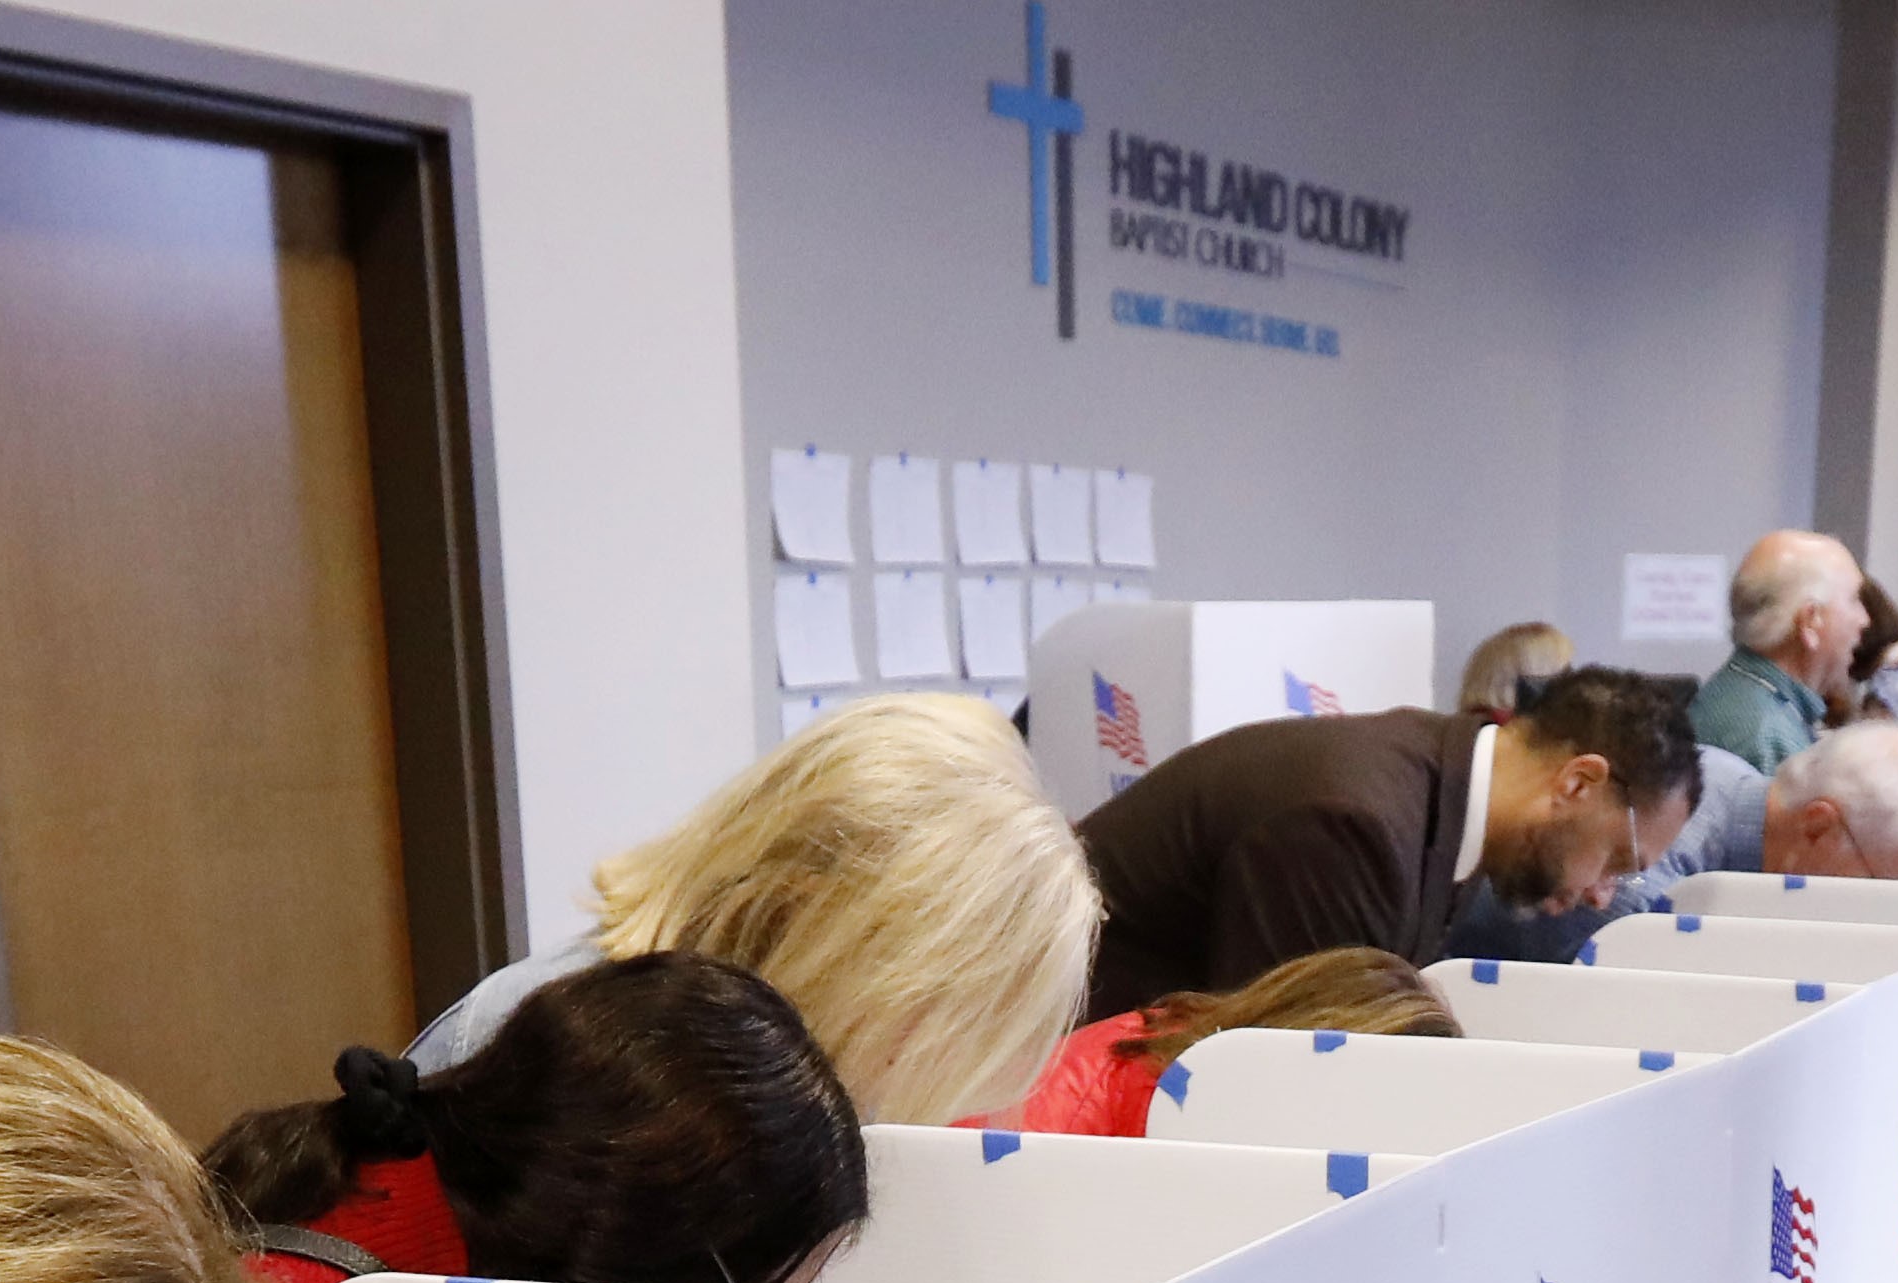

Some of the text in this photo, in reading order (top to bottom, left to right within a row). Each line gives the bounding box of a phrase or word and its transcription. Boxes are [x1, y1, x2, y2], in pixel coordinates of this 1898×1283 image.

[1109, 129, 1409, 262] HIGHLAND COLONY
[1196, 227, 1283, 278] CHURCH
